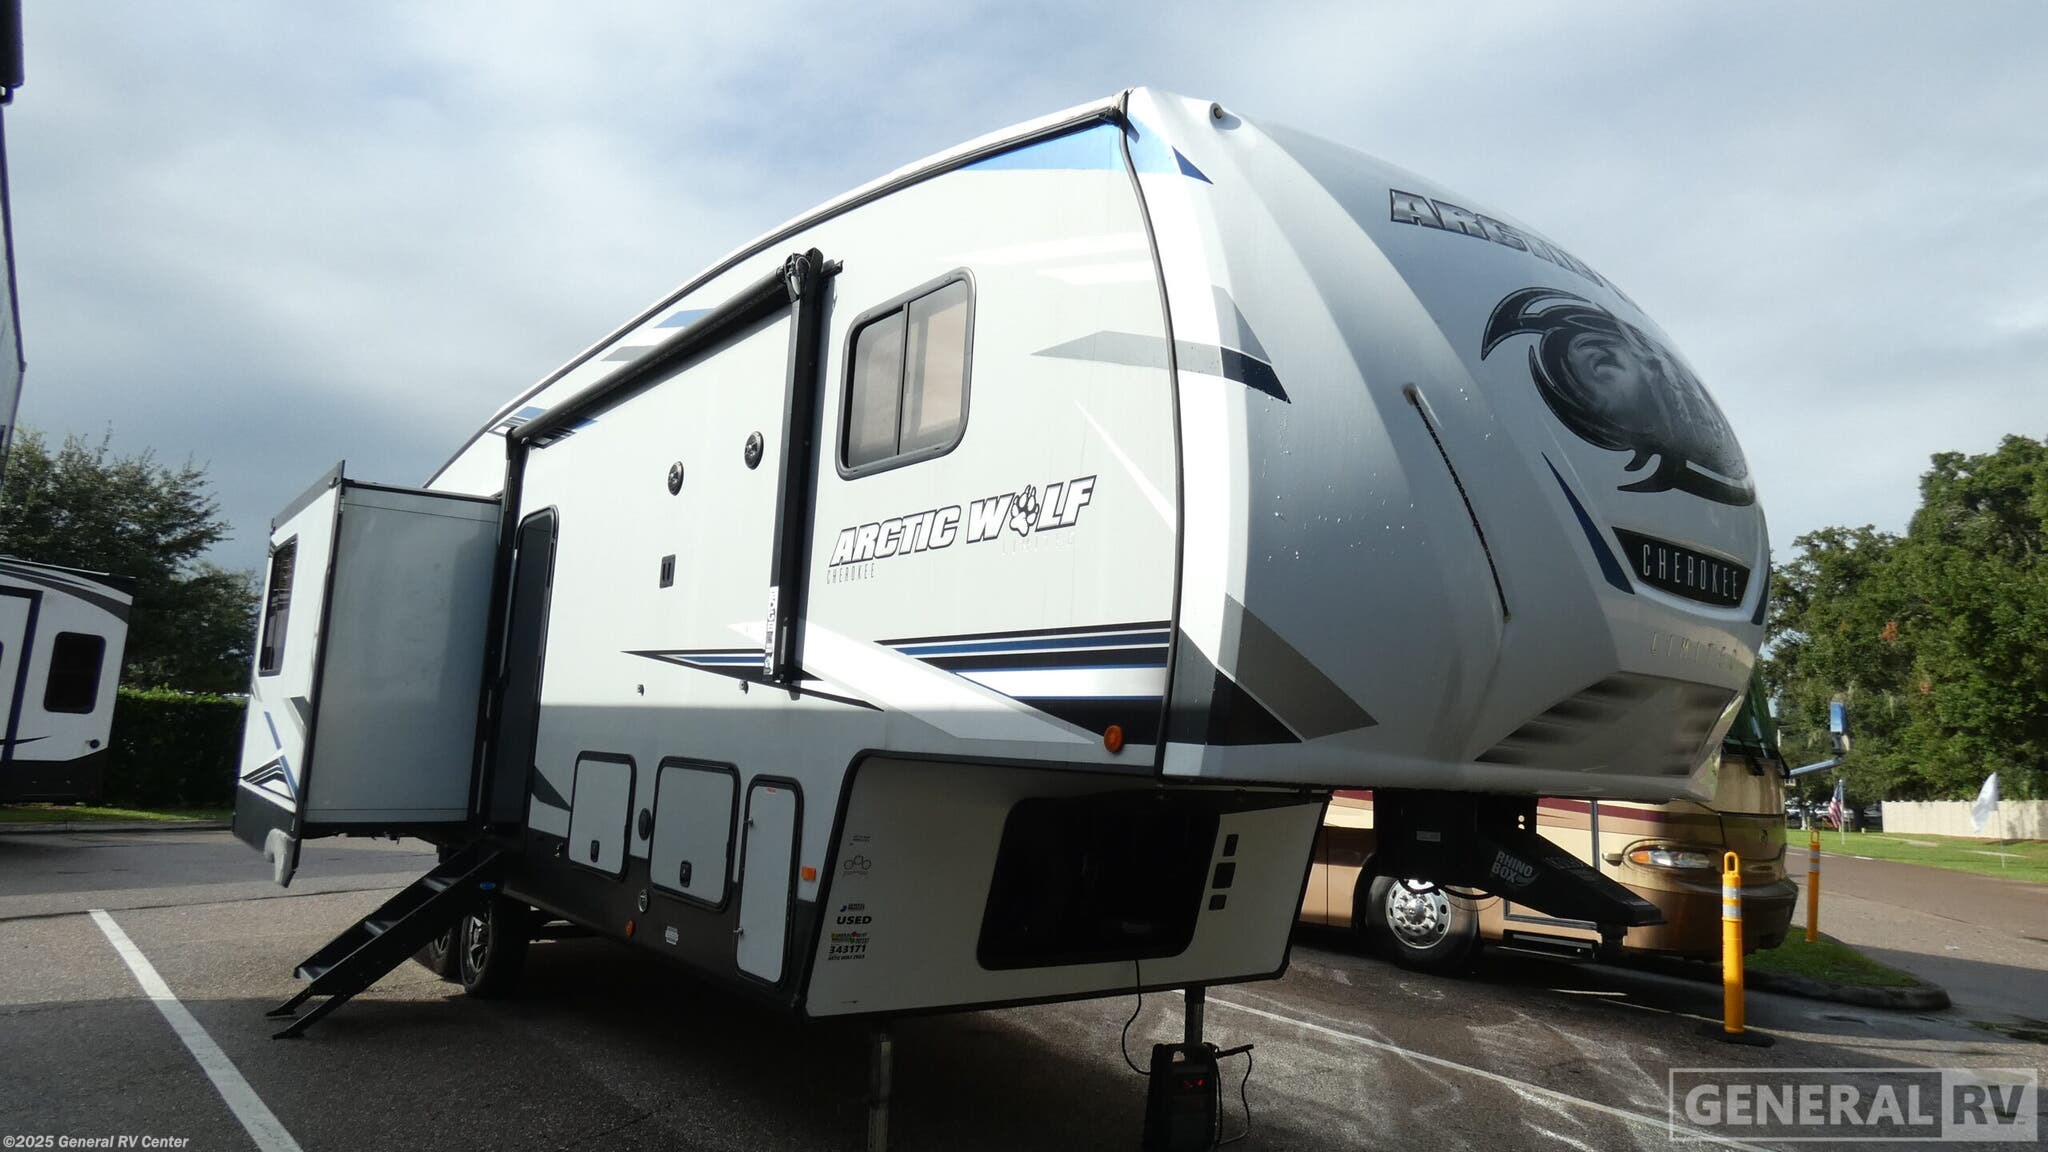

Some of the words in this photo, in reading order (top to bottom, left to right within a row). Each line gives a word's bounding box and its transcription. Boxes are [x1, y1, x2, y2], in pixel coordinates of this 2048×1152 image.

[828, 504, 961, 568] ARCTIC
[826, 562, 876, 584] CHEROKEE
[1643, 543, 1738, 600] CHEROKEE
[1491, 861, 1517, 883] BOX
[1495, 850, 1533, 877] RHINO
[837, 915, 872, 925] USED
[829, 945, 866, 954] 343171
